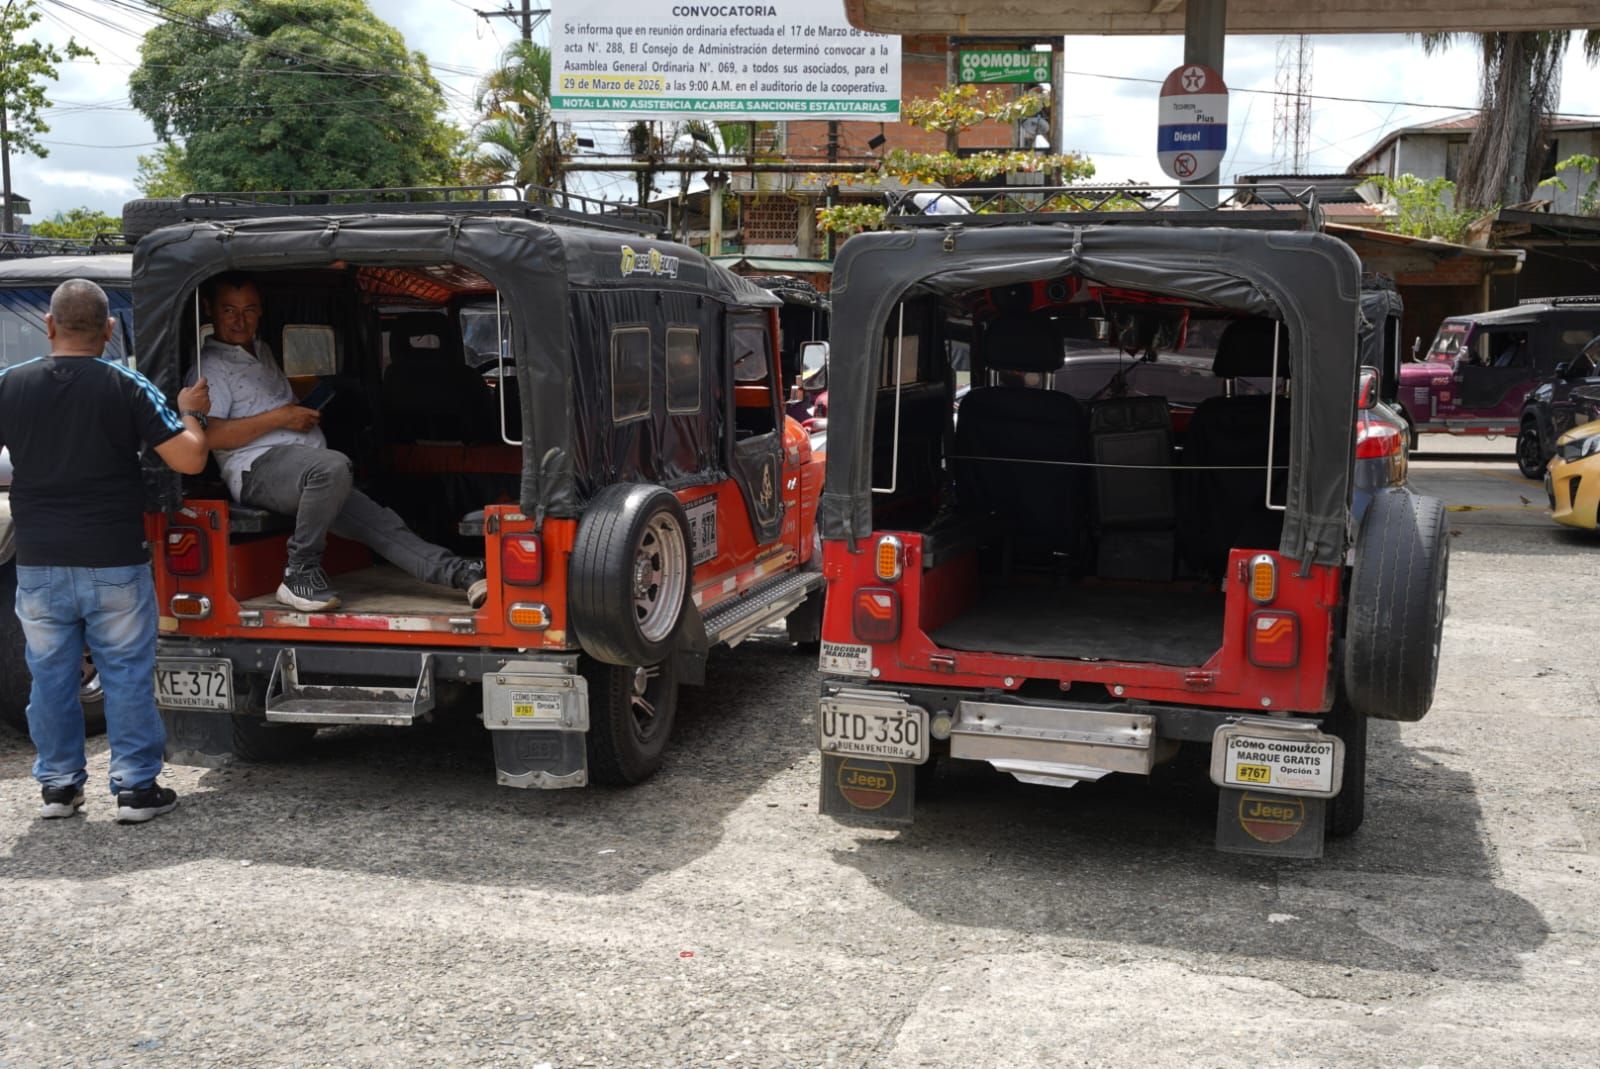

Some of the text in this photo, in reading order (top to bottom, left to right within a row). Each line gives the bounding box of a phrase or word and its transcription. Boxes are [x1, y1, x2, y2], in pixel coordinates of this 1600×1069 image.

[672, 6, 777, 17] CONVOCATORIA
[564, 24, 575, 35] Se
[577, 24, 613, 35] informa
[616, 27, 632, 38] que
[635, 27, 646, 35] en
[649, 25, 683, 36] reunión
[686, 25, 728, 36] ordinaria
[730, 25, 775, 36] efectuada
[777, 25, 786, 36] el
[791, 26, 801, 36] 17
[804, 25, 816, 36] de
[818, 26, 848, 36] Marzo
[564, 44, 583, 53] acta
[606, 43, 625, 55] 288,
[630, 43, 638, 54] El
[642, 43, 678, 57] Consejo
[683, 43, 694, 54] de
[698, 44, 767, 55] Administración
[772, 44, 819, 55] determinó
[824, 46, 865, 56] convocar
[870, 47, 876, 55] a
[880, 44, 889, 56] la
[564, 60, 608, 71] Asamblea
[612, 61, 648, 72] General
[652, 61, 695, 73] Ordinaria
[718, 62, 738, 74] 069,
[742, 65, 748, 73] a
[753, 63, 779, 73] todos
[783, 65, 799, 74] sus
[802, 62, 850, 75] asociados,
[854, 65, 876, 76] para
[880, 63, 889, 74] el
[564, 78, 888, 95] 29 de Marzo de 2026, a las 9:00 A.M. en el auditorio de la cooperativa.
[563, 99, 887, 112] NOTA: LA NO ASISTENCIA ACARREA SANCIONES ESTATUTARIAS
[1196, 114, 1214, 123] Plus
[1173, 131, 1200, 142] Diesel
[822, 643, 869, 655] VELOCIDAD
[837, 741, 905, 756] BUENAVENTURA
[1236, 751, 1322, 767] MARQUE GRATIS
[1240, 766, 1268, 778] #767
[1280, 766, 1312, 776] Opción
[848, 772, 887, 788] Jeep
[1249, 802, 1295, 820] Jeep
